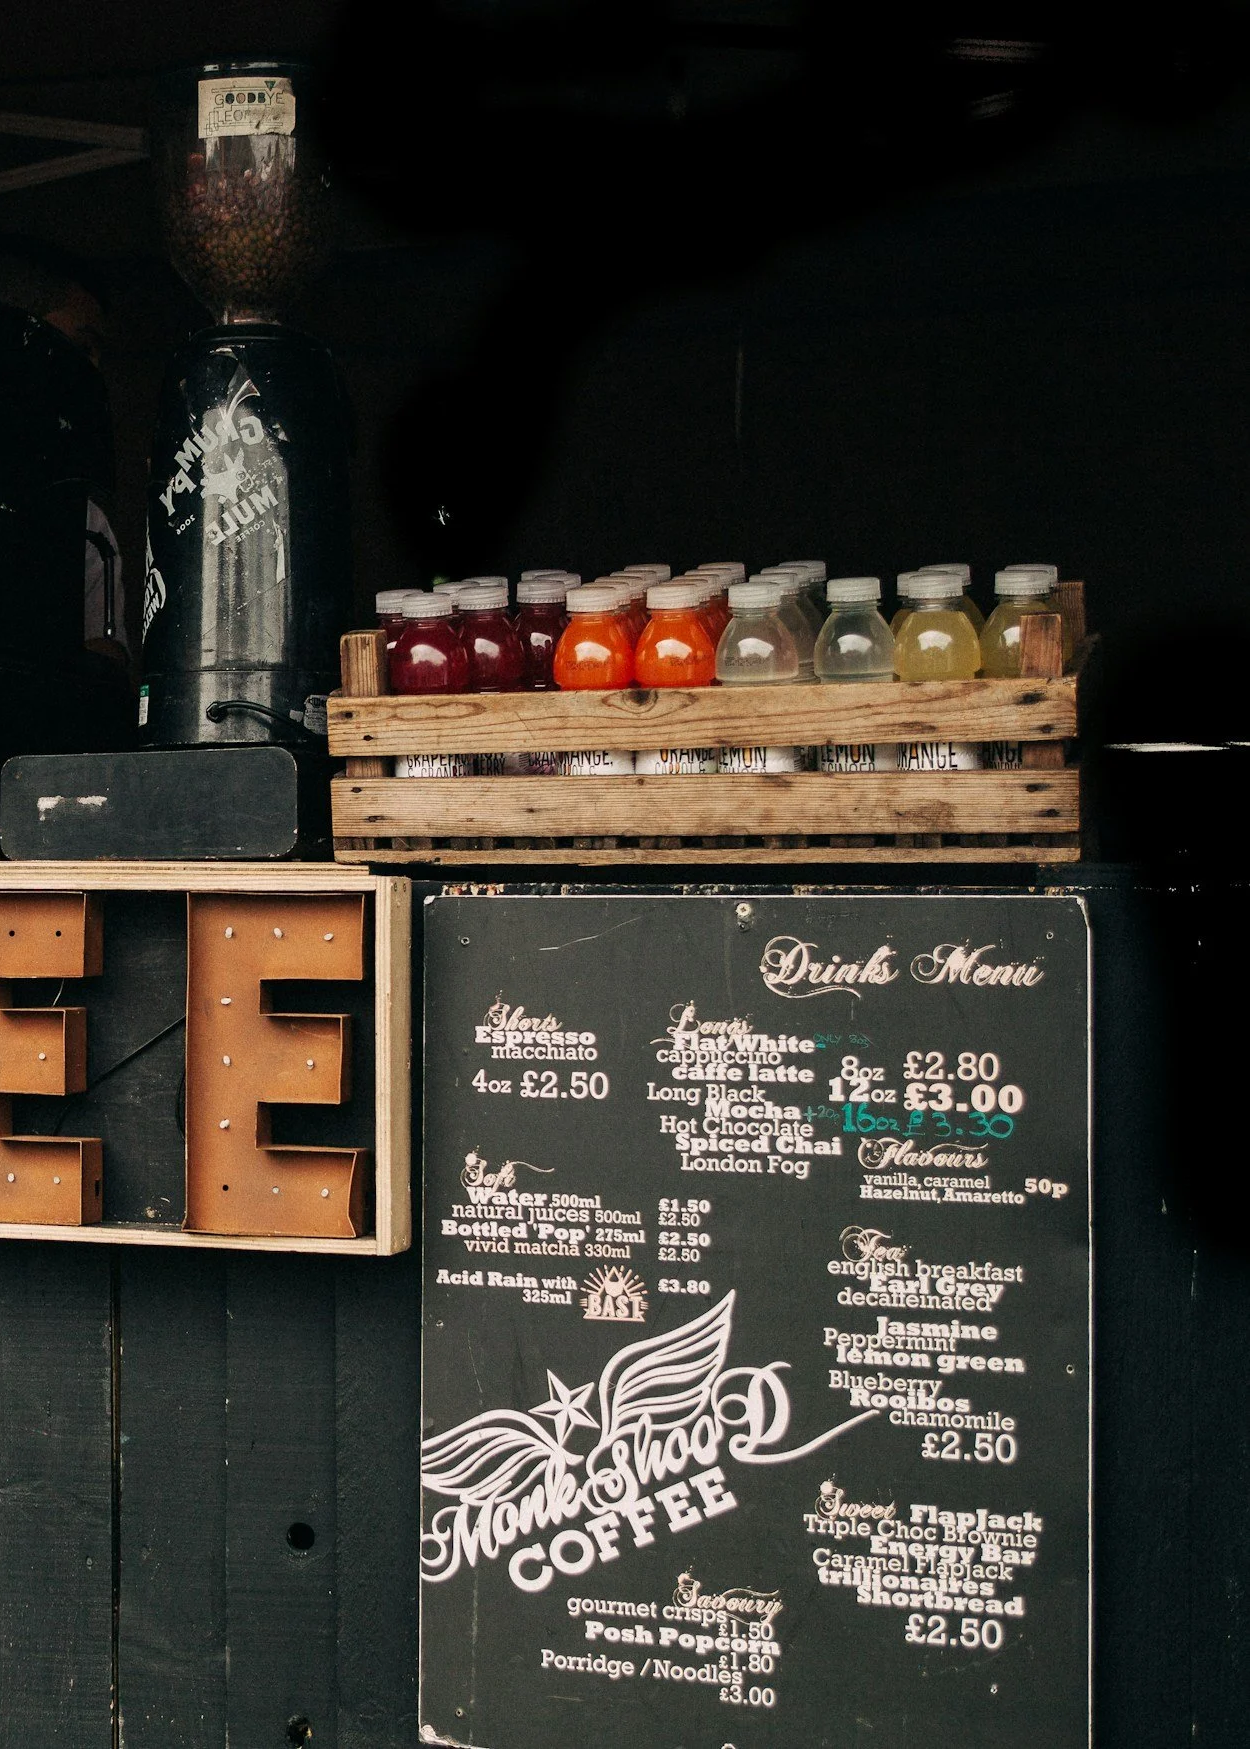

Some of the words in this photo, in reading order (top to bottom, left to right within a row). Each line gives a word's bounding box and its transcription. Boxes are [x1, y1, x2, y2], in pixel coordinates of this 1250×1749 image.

[214, 91, 285, 106] GOODBYE
[759, 935, 899, 998] Drinks
[910, 942, 1045, 986] Menu
[483, 1001, 562, 1031] Shorts
[475, 1025, 596, 1047] Espresso
[673, 1033, 729, 1052] Flat
[730, 1033, 816, 1053] White
[491, 1043, 598, 1061] macchiato
[656, 1049, 782, 1069] cappuccino
[672, 1063, 743, 1081] caffe
[748, 1064, 815, 1083] latte
[840, 1055, 885, 1081] 8oz
[903, 1050, 1000, 1082] £2.80
[472, 1068, 512, 1094] 4oz
[520, 1070, 609, 1099] £2.50
[646, 1082, 701, 1106] Long
[706, 1084, 766, 1103] Black
[828, 1076, 896, 1103] 12oz
[903, 1082, 1023, 1114] £3.00
[704, 1100, 802, 1120] Mocha
[841, 1102, 900, 1133] 16oz
[659, 1115, 697, 1134] Hot
[703, 1117, 814, 1137] Chocolate
[675, 1133, 770, 1156] Spiced
[776, 1136, 842, 1155] Chai
[857, 1136, 989, 1170] Flavours
[460, 1152, 554, 1190] Soft
[680, 1153, 763, 1173] London
[767, 1155, 810, 1179] Fog
[863, 1172, 922, 1190] vanilla,
[923, 1173, 990, 1189] caramel
[1024, 1178, 1068, 1199] 50p
[466, 1186, 548, 1207] Water
[551, 1194, 601, 1209] 500ml
[658, 1198, 711, 1214] £1.50
[943, 1187, 1025, 1205] Amaretto
[452, 1203, 523, 1221] natural
[527, 1204, 590, 1225] juices
[594, 1210, 642, 1225] 500ml
[658, 1212, 700, 1228] £2.50
[441, 1220, 528, 1240] Bottled
[533, 1223, 591, 1245] 'Pop'
[595, 1227, 646, 1244] 275ml
[658, 1232, 711, 1248] £2.50
[464, 1237, 510, 1254] vivid
[514, 1240, 580, 1257] matcha
[584, 1244, 631, 1259] 330ml
[658, 1247, 700, 1263] £2.50
[436, 1269, 484, 1286] Acid
[487, 1271, 539, 1289] Rain
[541, 1276, 578, 1291] with
[827, 1257, 910, 1280] english
[915, 1259, 1024, 1283] breakfast
[522, 1289, 573, 1305] 325ml
[658, 1279, 711, 1295] £3.80
[836, 1287, 993, 1312] decaffeinated
[869, 1273, 930, 1294] Earl
[935, 1277, 1004, 1302] Grey
[823, 1327, 957, 1352] Peppermint
[876, 1316, 998, 1341] Jasmine
[836, 1345, 932, 1368] lemon
[936, 1354, 1025, 1374] green
[828, 1369, 942, 1395] Blueberry
[849, 1387, 971, 1413] Rooibos
[889, 1407, 1015, 1431] chamomile
[921, 1431, 1016, 1464] £2.50
[814, 1482, 897, 1519] Sweet
[508, 1466, 738, 1593] COFFEE
[803, 1513, 871, 1539] Triple
[877, 1519, 937, 1541] Choc
[942, 1525, 1037, 1548] Brownie
[869, 1535, 975, 1563] Energy
[980, 1543, 1036, 1566] Bar
[812, 1548, 910, 1573] Caramel
[915, 1555, 1013, 1581] Flapjack
[817, 1566, 995, 1597] trillionaires
[566, 1596, 658, 1619] gourmet
[662, 1604, 728, 1628] crisps
[672, 1578, 784, 1624] Savoury
[856, 1584, 1025, 1617] Shortbread
[584, 1620, 654, 1645] Posh
[658, 1626, 781, 1656] Popcorn
[718, 1620, 773, 1641] £1.50
[904, 1613, 1002, 1650] £2.50
[540, 1649, 635, 1679] Porridge
[718, 1652, 774, 1674] £1.80
[719, 1685, 775, 1707] £3.00
